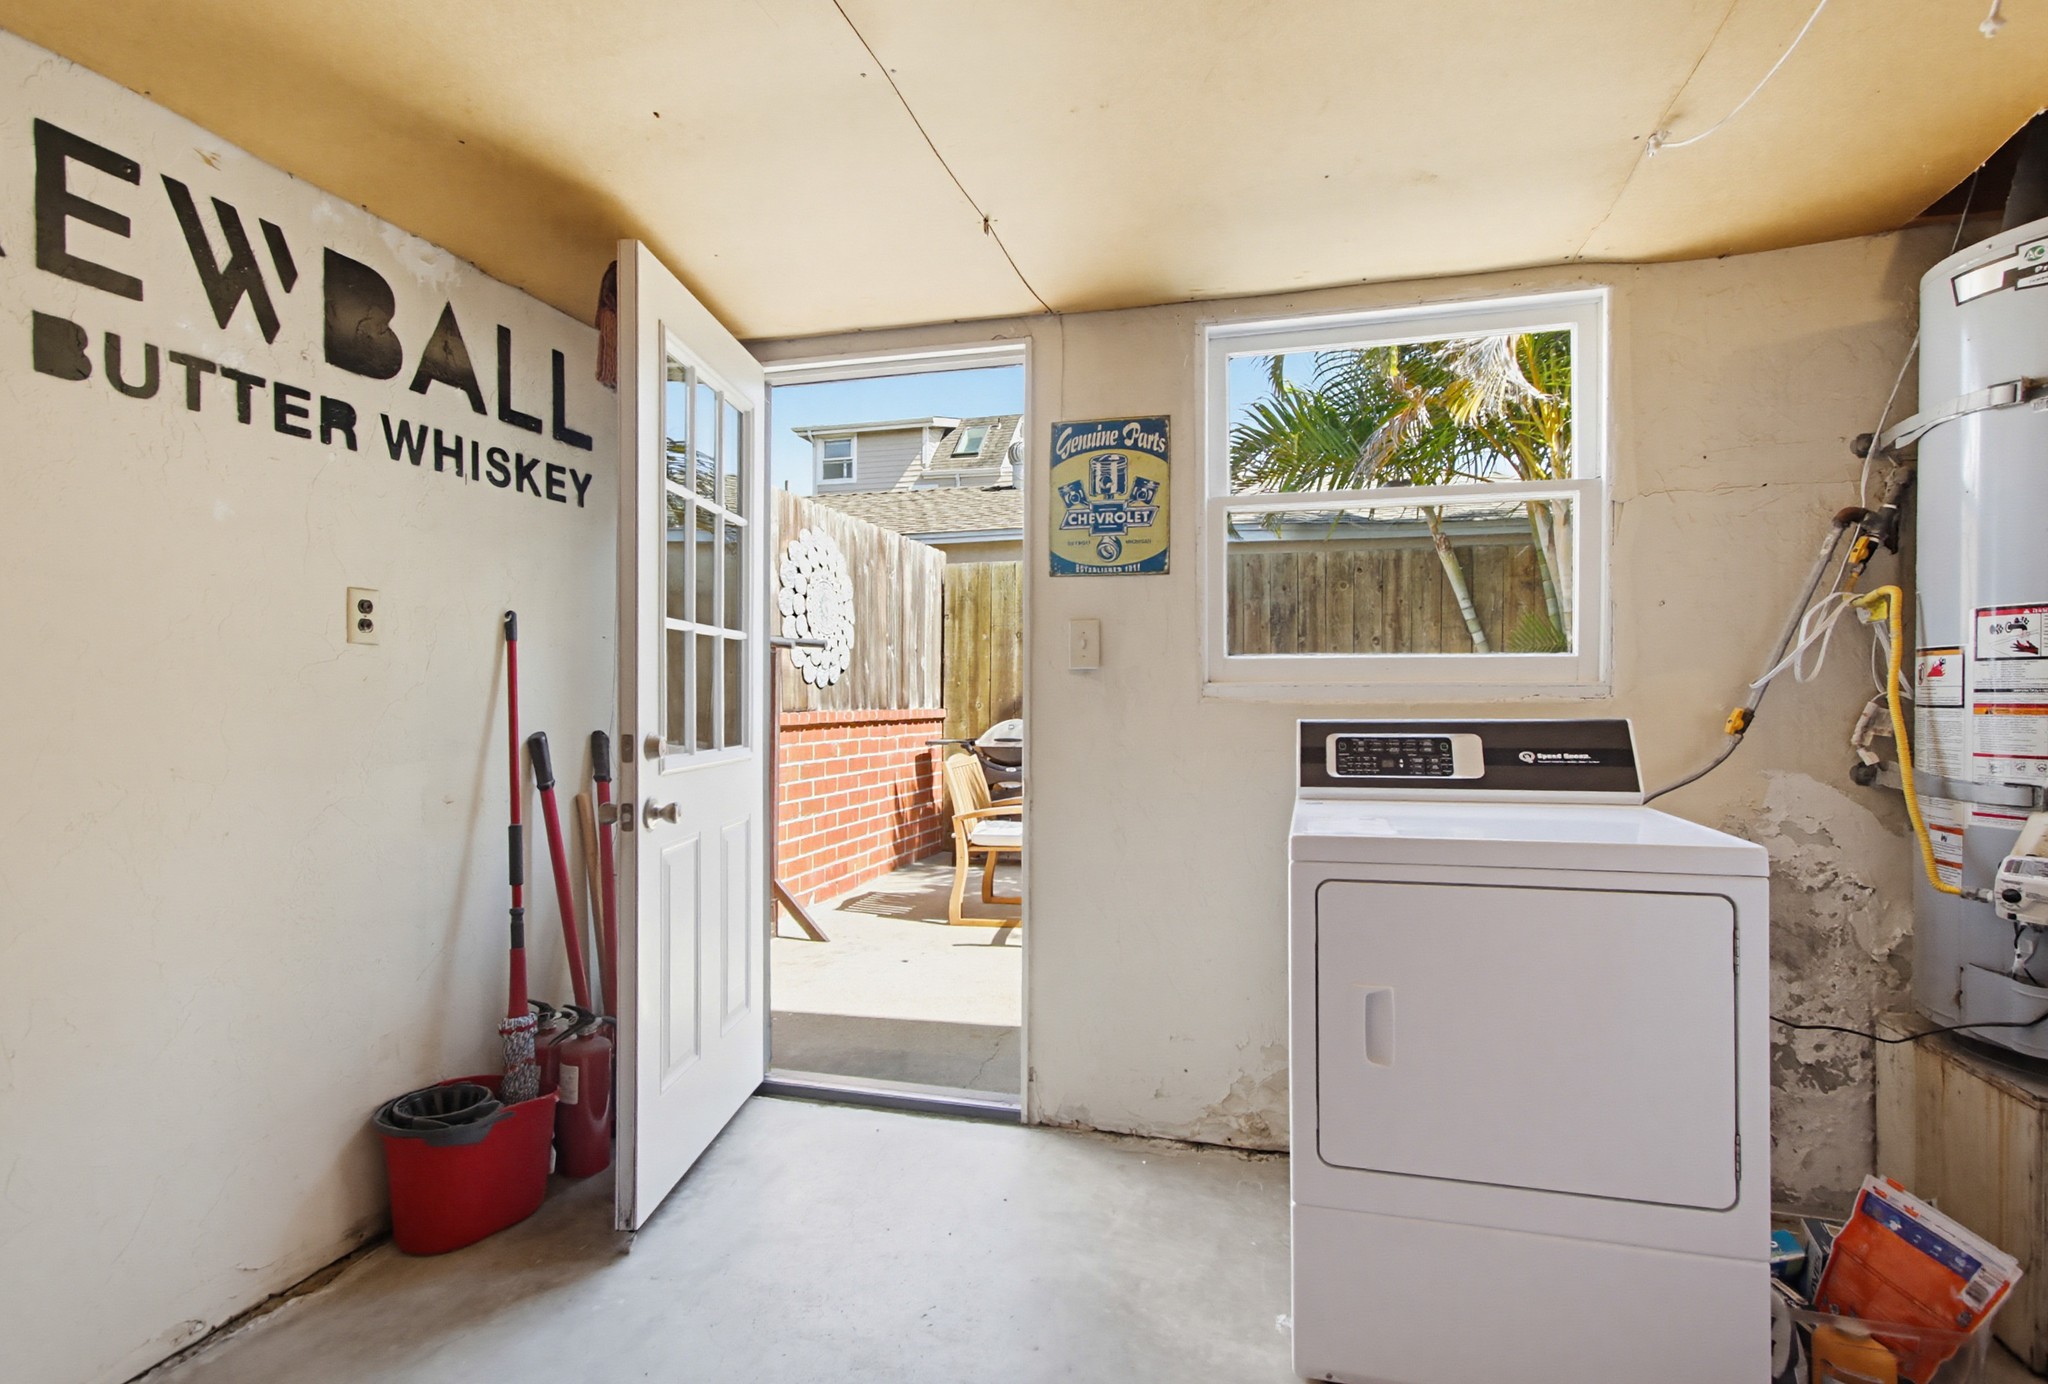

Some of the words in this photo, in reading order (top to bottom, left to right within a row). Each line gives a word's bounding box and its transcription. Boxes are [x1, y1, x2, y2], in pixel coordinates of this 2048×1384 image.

[0, 117, 593, 451] EWBALL
[32, 309, 358, 452] BUTTER
[380, 412, 593, 508] WHISKEY
[1056, 424, 1119, 459] Genuine
[1122, 422, 1166, 453] Parts
[1067, 510, 1150, 526] CHEVROLET
